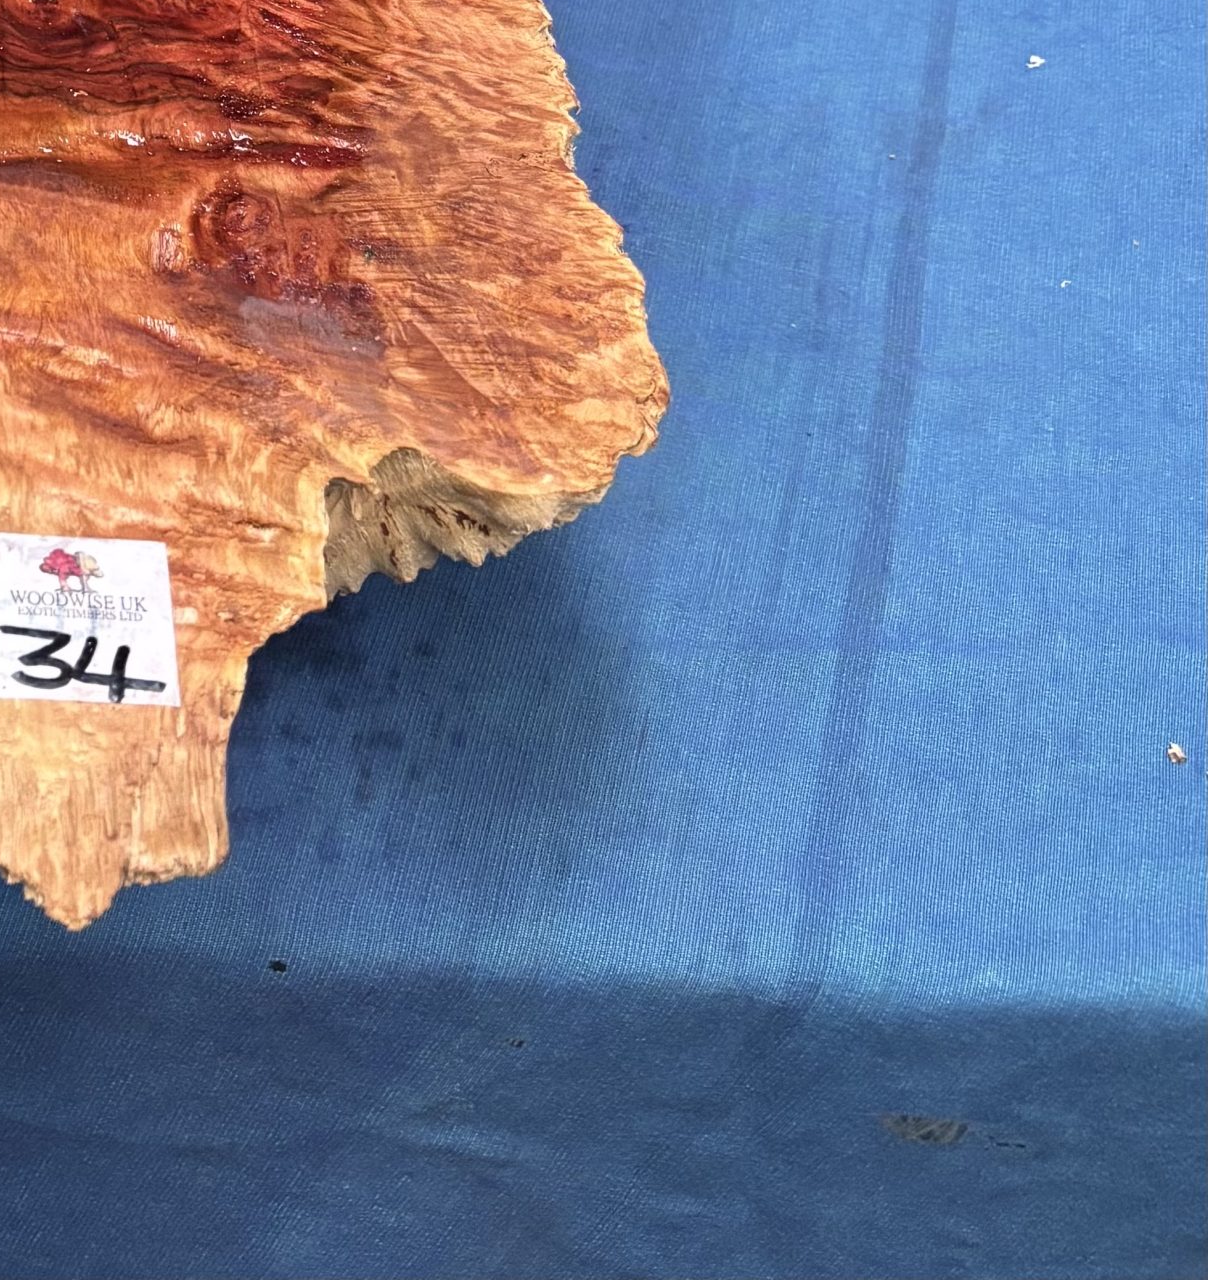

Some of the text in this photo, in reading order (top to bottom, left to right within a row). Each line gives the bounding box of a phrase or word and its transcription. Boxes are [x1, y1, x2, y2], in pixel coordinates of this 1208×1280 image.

[10, 589, 148, 612] WOODWISE UK
[17, 606, 62, 617] EXOTIC
[119, 610, 144, 622] LTD
